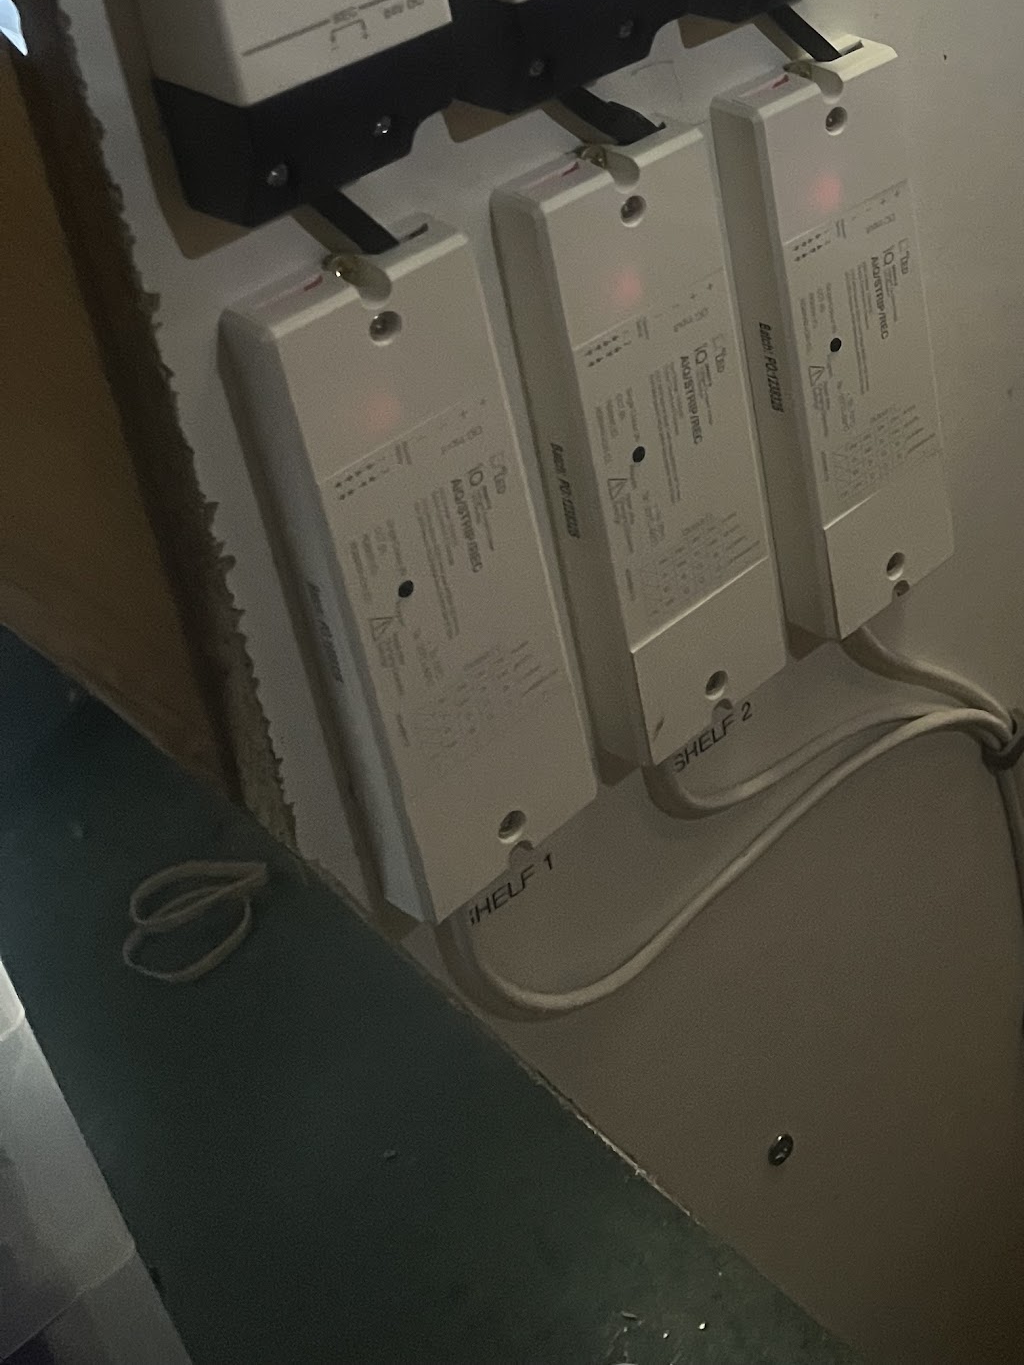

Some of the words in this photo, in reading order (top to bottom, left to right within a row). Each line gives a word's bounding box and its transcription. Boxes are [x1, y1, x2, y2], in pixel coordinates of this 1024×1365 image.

[679, 352, 703, 446] AIQ/STRIP/REC
[674, 713, 735, 773] SHELF
[741, 701, 753, 722] 2
[543, 854, 553, 871] 1
